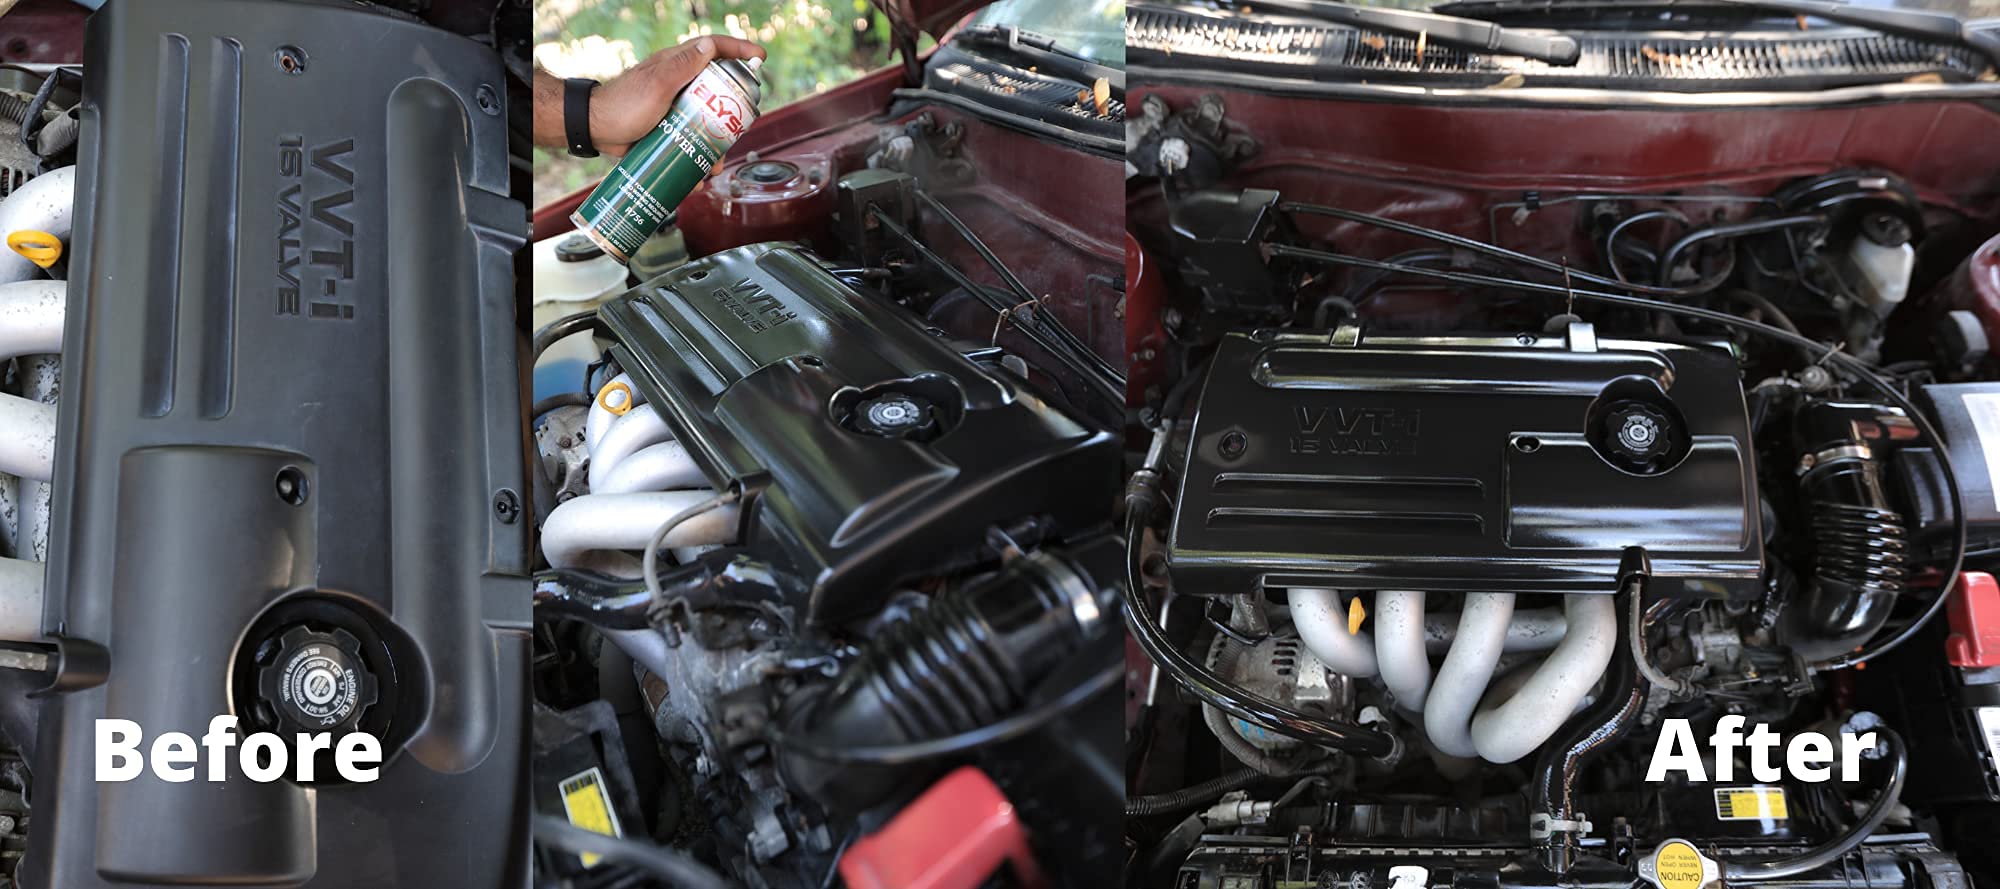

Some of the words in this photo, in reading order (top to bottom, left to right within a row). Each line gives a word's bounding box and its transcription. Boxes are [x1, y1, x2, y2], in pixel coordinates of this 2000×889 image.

[279, 135, 302, 176] 16
[658, 118, 697, 158] POWER
[687, 131, 709, 153] PLASTIC
[311, 139, 354, 320] VVT-i
[624, 205, 645, 226] R756
[276, 184, 301, 315] VALVE
[344, 668, 357, 705] ENGINE
[336, 704, 350, 718] OIL
[1660, 871, 1700, 882] CAUTION
